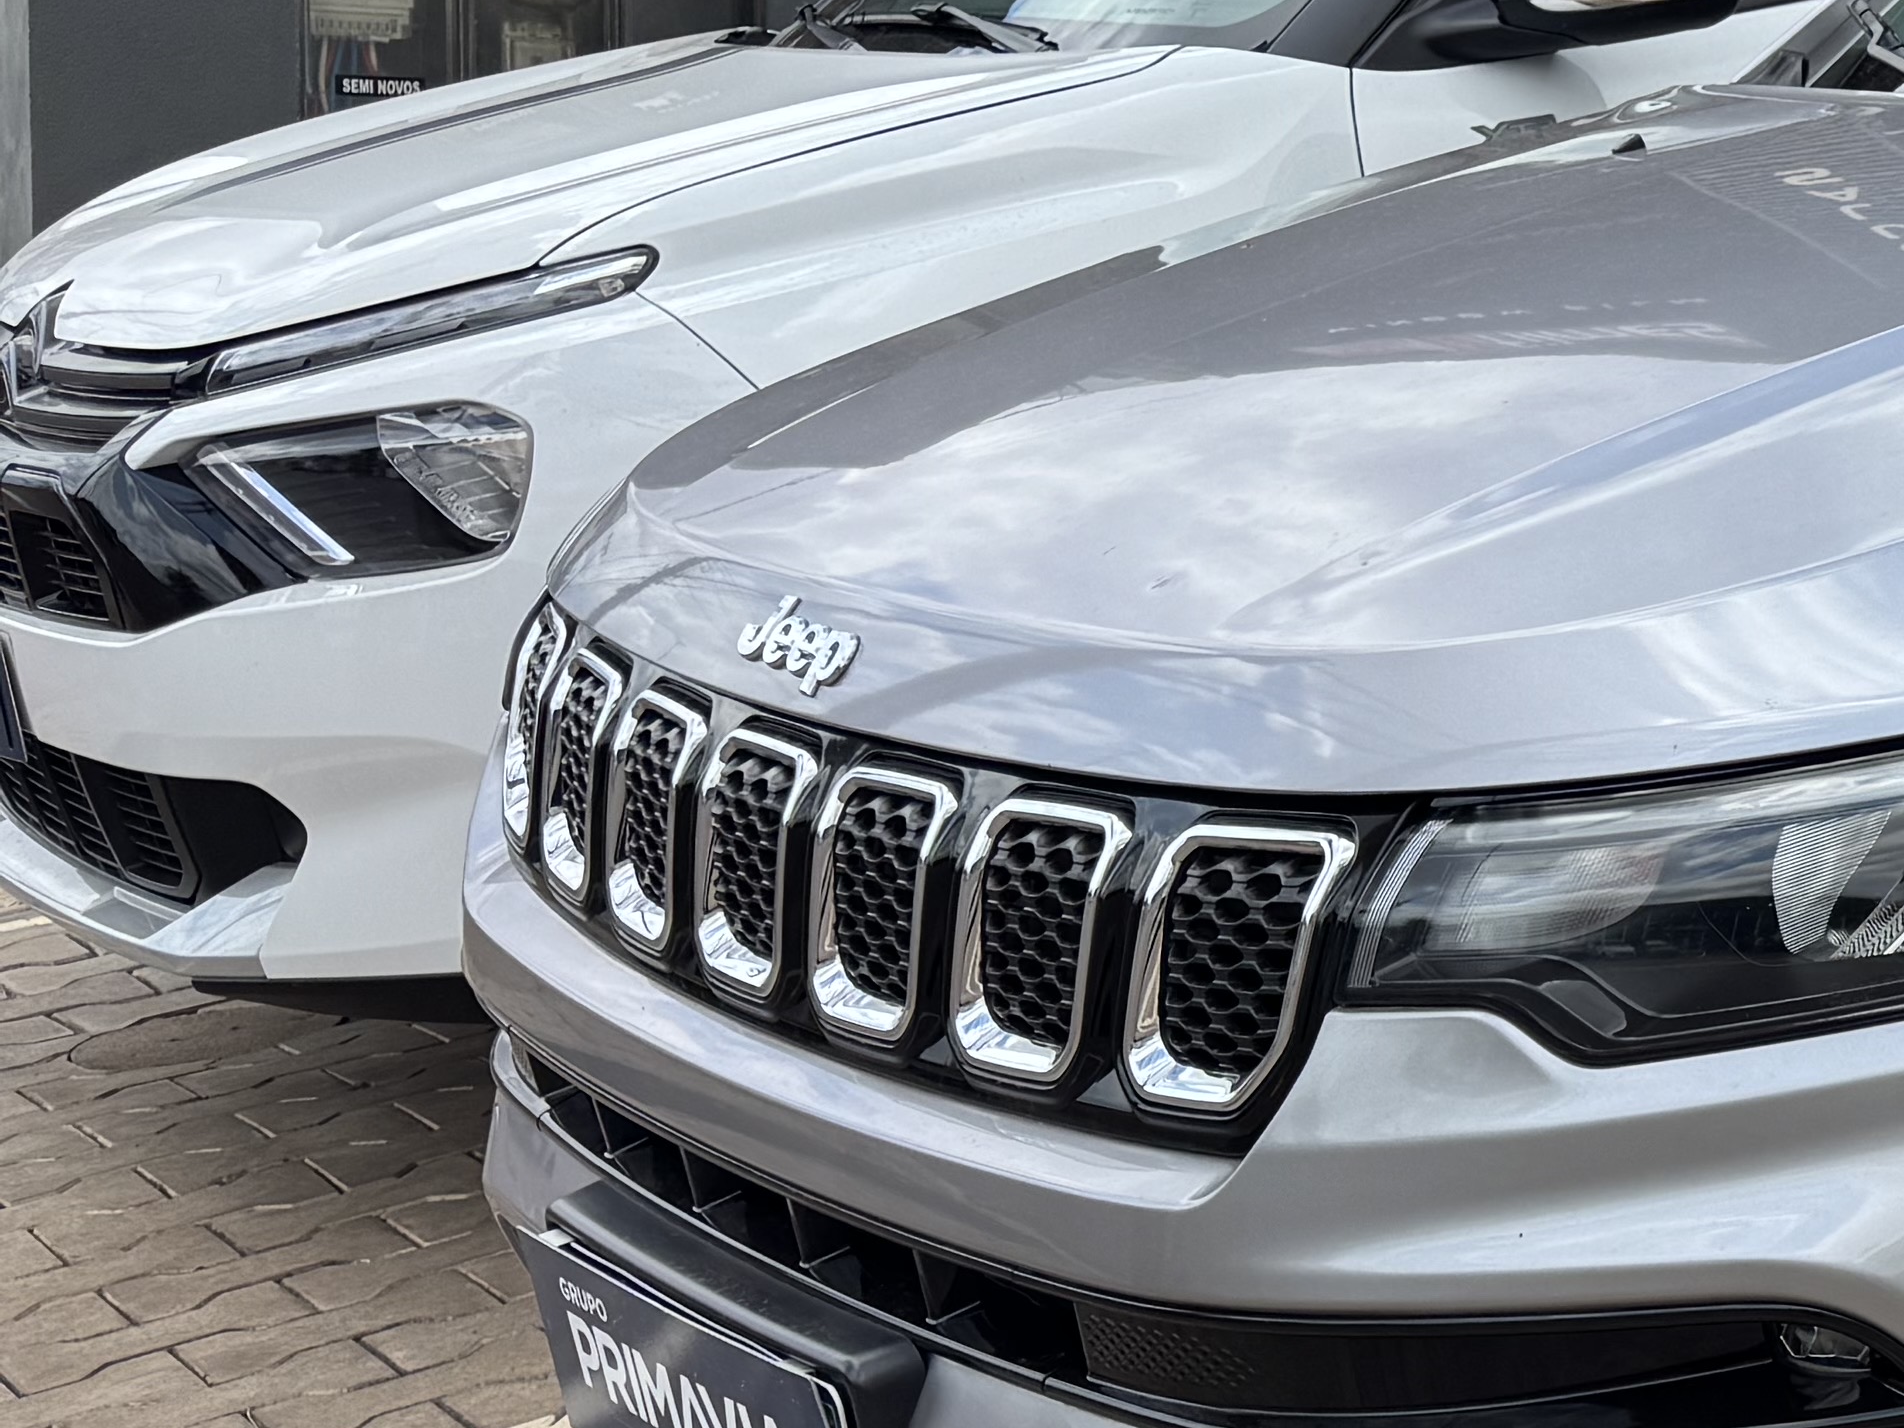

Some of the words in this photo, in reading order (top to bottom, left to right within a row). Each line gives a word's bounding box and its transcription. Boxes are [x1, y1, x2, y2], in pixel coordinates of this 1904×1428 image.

[342, 78, 374, 94] SEMI
[377, 79, 420, 95] NOVOS
[737, 594, 862, 699] Jeep
[558, 1276, 608, 1323] GRUPO
